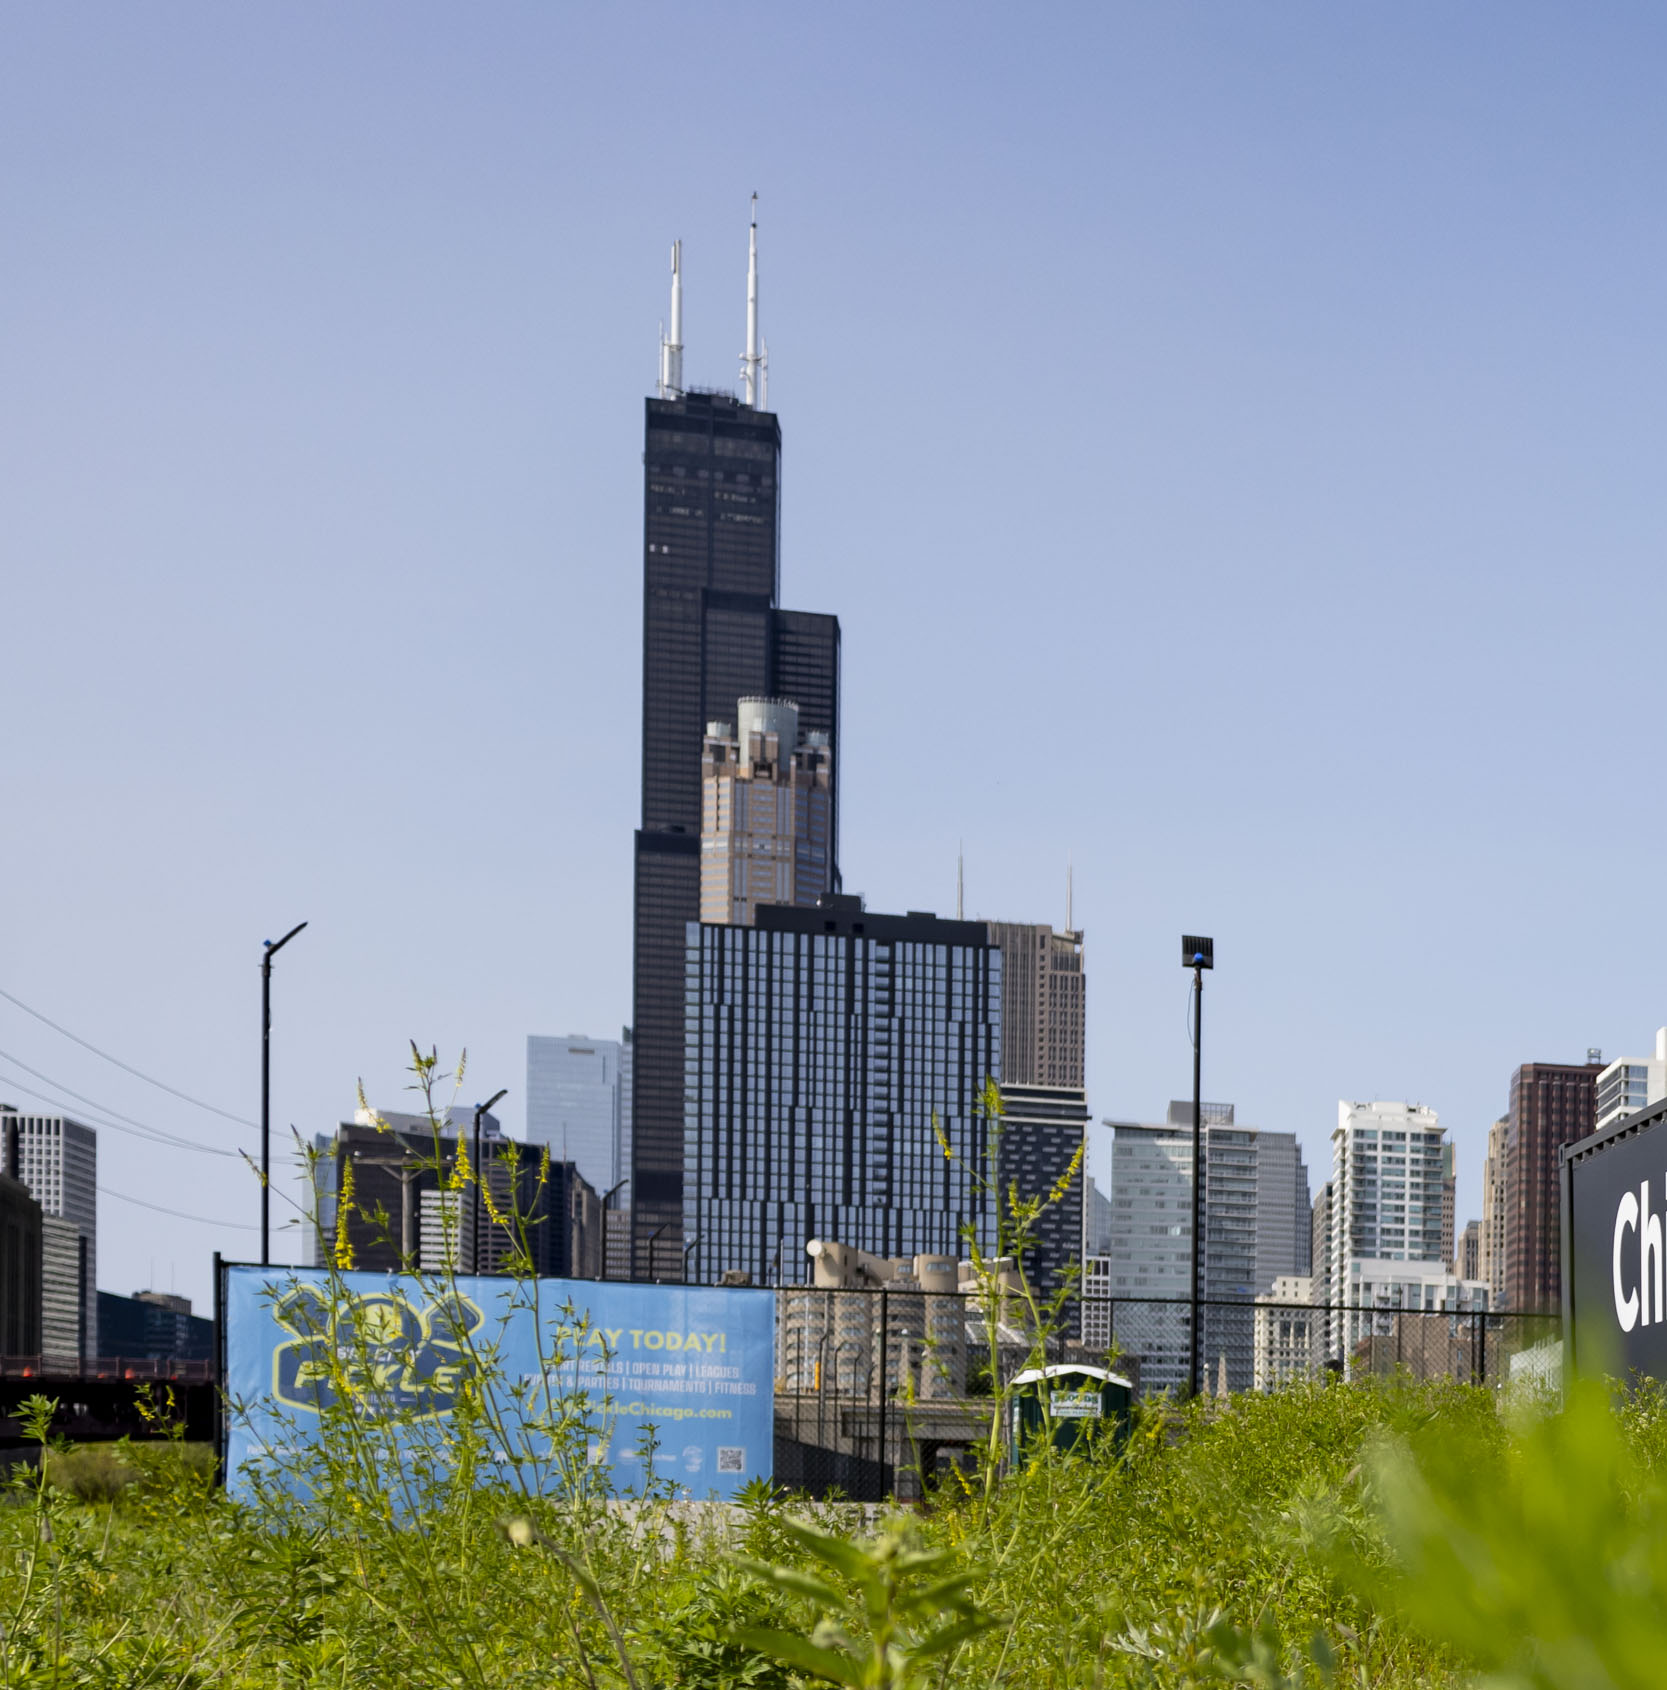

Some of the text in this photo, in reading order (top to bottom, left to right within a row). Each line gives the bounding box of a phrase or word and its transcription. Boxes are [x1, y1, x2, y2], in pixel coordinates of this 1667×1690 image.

[556, 1327, 727, 1353] PLAY TODAY!
[632, 1362, 659, 1375] OPEN
[663, 1363, 686, 1376] PLAY
[695, 1364, 740, 1379] LEAGUES
[629, 1379, 706, 1393] TOURNAMENTS
[715, 1382, 757, 1396] FITNESS
